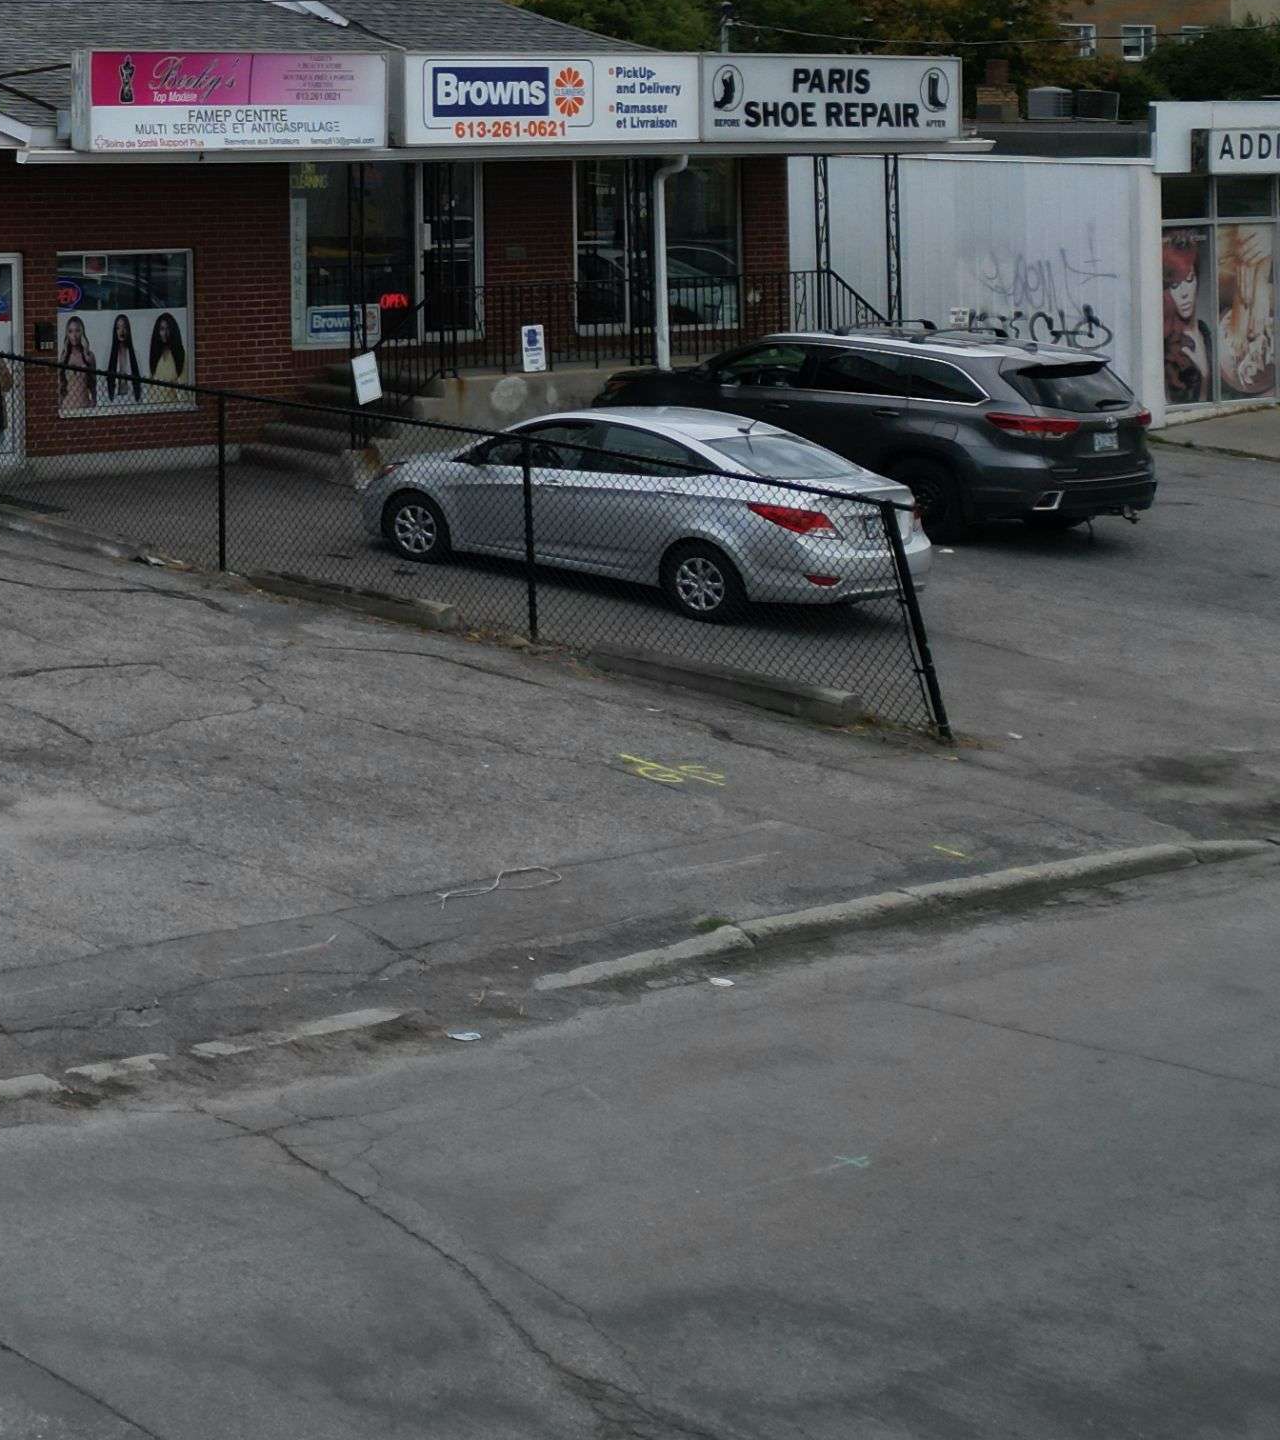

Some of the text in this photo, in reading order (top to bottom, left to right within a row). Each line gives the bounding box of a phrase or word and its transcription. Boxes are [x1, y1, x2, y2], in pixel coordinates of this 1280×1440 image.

[792, 68, 871, 95] PARIS
[436, 72, 546, 106] Browns
[616, 83, 682, 96] and Delivery
[153, 91, 167, 103] Top
[615, 101, 669, 115] Ramasser
[744, 101, 920, 128] SHOE REPAIR
[189, 109, 288, 122] FAMEP CENTRE
[616, 116, 678, 129] et Livraison
[135, 121, 340, 135] MULTI SERVICES ET ANTIGASPILLAGE
[454, 120, 567, 138] 613-261-0621
[714, 118, 740, 128] BEFORE
[926, 120, 946, 128] AFTER
[160, 136, 189, 148] Support
[1219, 133, 1280, 160] ADD
[380, 293, 409, 309] OPEN
[312, 313, 361, 329] Brown
